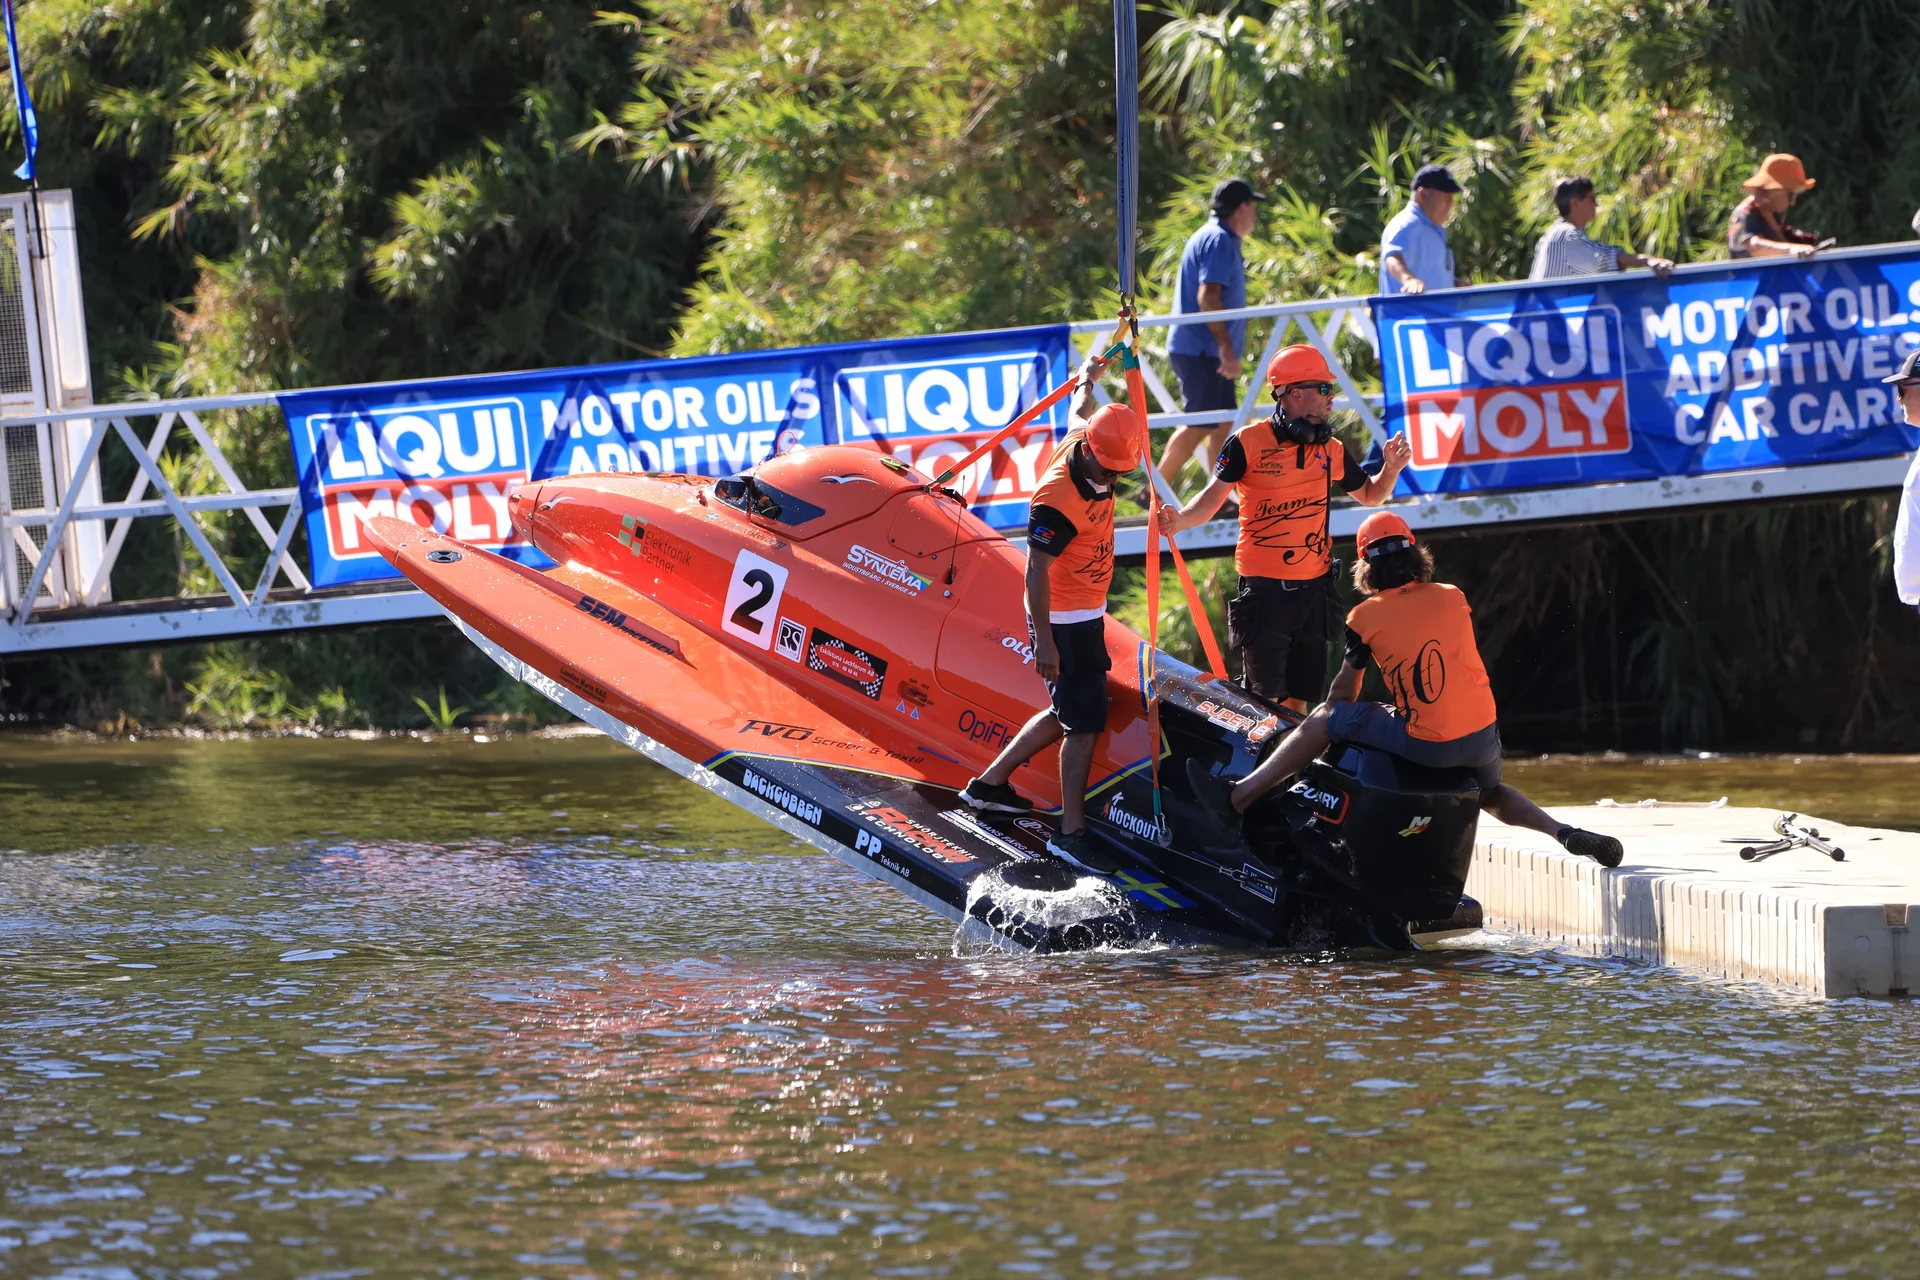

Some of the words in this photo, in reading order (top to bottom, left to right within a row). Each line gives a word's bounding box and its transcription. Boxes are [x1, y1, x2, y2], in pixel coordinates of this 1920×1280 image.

[1641, 291, 1815, 348] MOTOR
[1408, 315, 1610, 387] LIQUI
[541, 386, 708, 439] MOTOR
[716, 377, 820, 425] OILS
[847, 362, 1041, 437] LIQUI
[1418, 385, 1621, 461] MOLY
[1675, 395, 1779, 446] CAR
[323, 407, 518, 480] LIQUI
[335, 478, 526, 550] MOLY
[1035, 525, 1056, 539] F2
[1254, 497, 1311, 519] Team
[641, 546, 675, 575] Partner
[643, 530, 693, 567] Elektronik
[847, 544, 922, 591] SYNTEMA
[574, 595, 627, 628] SEM
[730, 568, 775, 635] 2
[884, 579, 909, 594] SVERIGE
[907, 589, 918, 598] AB
[781, 624, 802, 652] RS
[820, 646, 843, 662] Eskilstuna
[811, 736, 866, 752] Screen
[884, 750, 925, 765] Textil
[742, 768, 823, 826] DÄCKGUBBEN
[855, 828, 882, 857] PP
[880, 854, 900, 873] Teknik
[899, 865, 910, 878] AB
[858, 810, 955, 864] TECHNOLOGY
[905, 818, 979, 861] SMÖRJTEKNIK
[953, 808, 1004, 838] BARKMANS
[1024, 849, 1041, 858] AB
